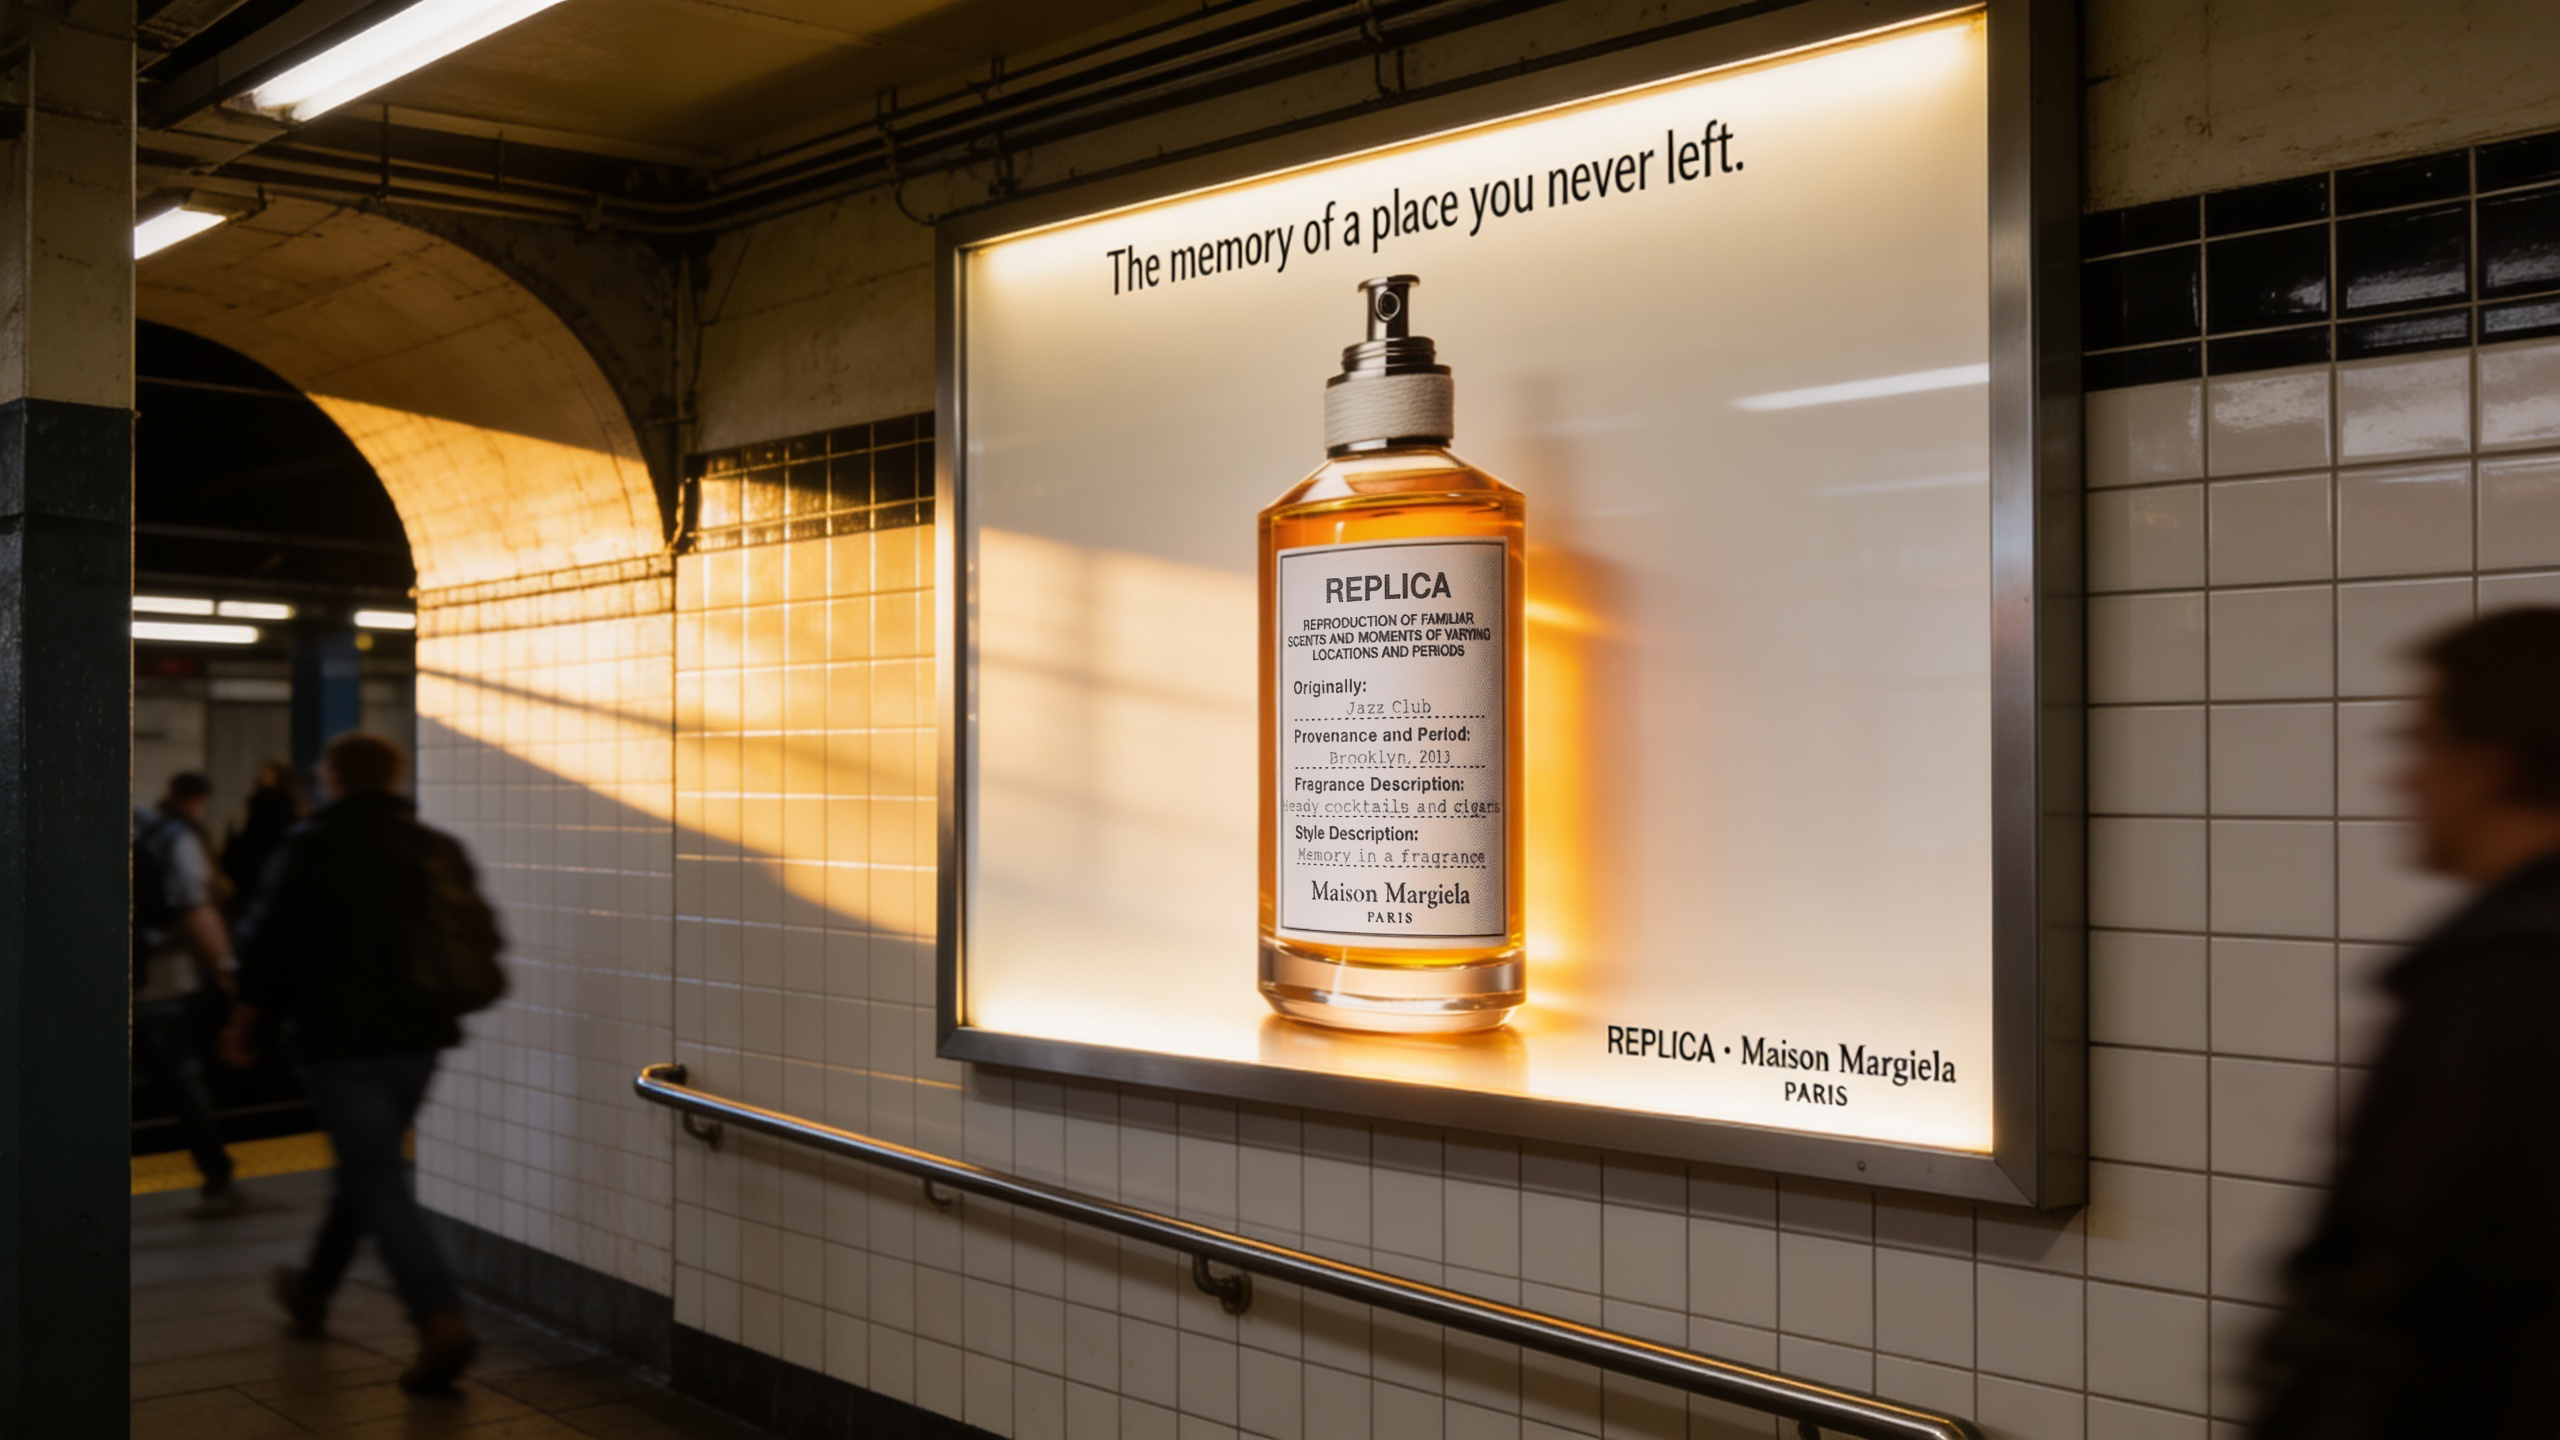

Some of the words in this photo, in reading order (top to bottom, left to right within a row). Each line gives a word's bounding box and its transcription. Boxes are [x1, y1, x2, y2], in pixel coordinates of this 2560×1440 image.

[1107, 245, 1160, 296] The
[1171, 225, 1294, 283] memory
[1304, 201, 1336, 255] of
[1344, 211, 1360, 247] a
[1373, 187, 1458, 254] place
[1469, 174, 1533, 237] you
[1548, 149, 1654, 208] never
[1667, 119, 1744, 184] left.
[1326, 571, 1452, 604] REPLICA
[1303, 614, 1397, 632] REPRODUCTION
[1400, 613, 1418, 626] OF
[1421, 611, 1475, 625] FAMILIAR
[1288, 634, 1327, 648] SCENTS
[1329, 632, 1354, 645] AND
[1358, 629, 1422, 644] MOMENTS
[1426, 629, 1442, 641] OF
[1444, 627, 1491, 641] VARYING
[1312, 646, 1379, 661] LOCATIONS
[1381, 645, 1409, 659] AND
[1412, 644, 1465, 657] PERIODS
[1293, 679, 1367, 698] Originally:
[1346, 701, 1385, 716] Jazz
[1392, 699, 1431, 714] Club
[1294, 729, 1378, 743] Provenance
[1383, 727, 1413, 742] and
[1417, 726, 1471, 742] Period:
[1329, 751, 1412, 766] Brooklyn,
[1419, 750, 1450, 764] 2013
[1294, 776, 1365, 794] Fragrance
[1370, 776, 1465, 794] Description:
[1325, 799, 1409, 814] cocktails
[1417, 799, 1447, 813] and
[1295, 825, 1325, 843] Style
[1329, 825, 1419, 844] Description:
[1298, 848, 1351, 864] Memory
[1359, 849, 1377, 863] in
[1384, 851, 1394, 863] a
[1401, 849, 1485, 868] fragrance
[1311, 880, 1378, 903] Maison
[1384, 881, 1471, 909] Margiela
[1367, 911, 1413, 924] PARIS
[1608, 1025, 1715, 1063] REPLICA
[1741, 1035, 1830, 1072] Maison
[1838, 1043, 1957, 1086] Margiela
[1785, 1082, 1848, 1106] PARIS
